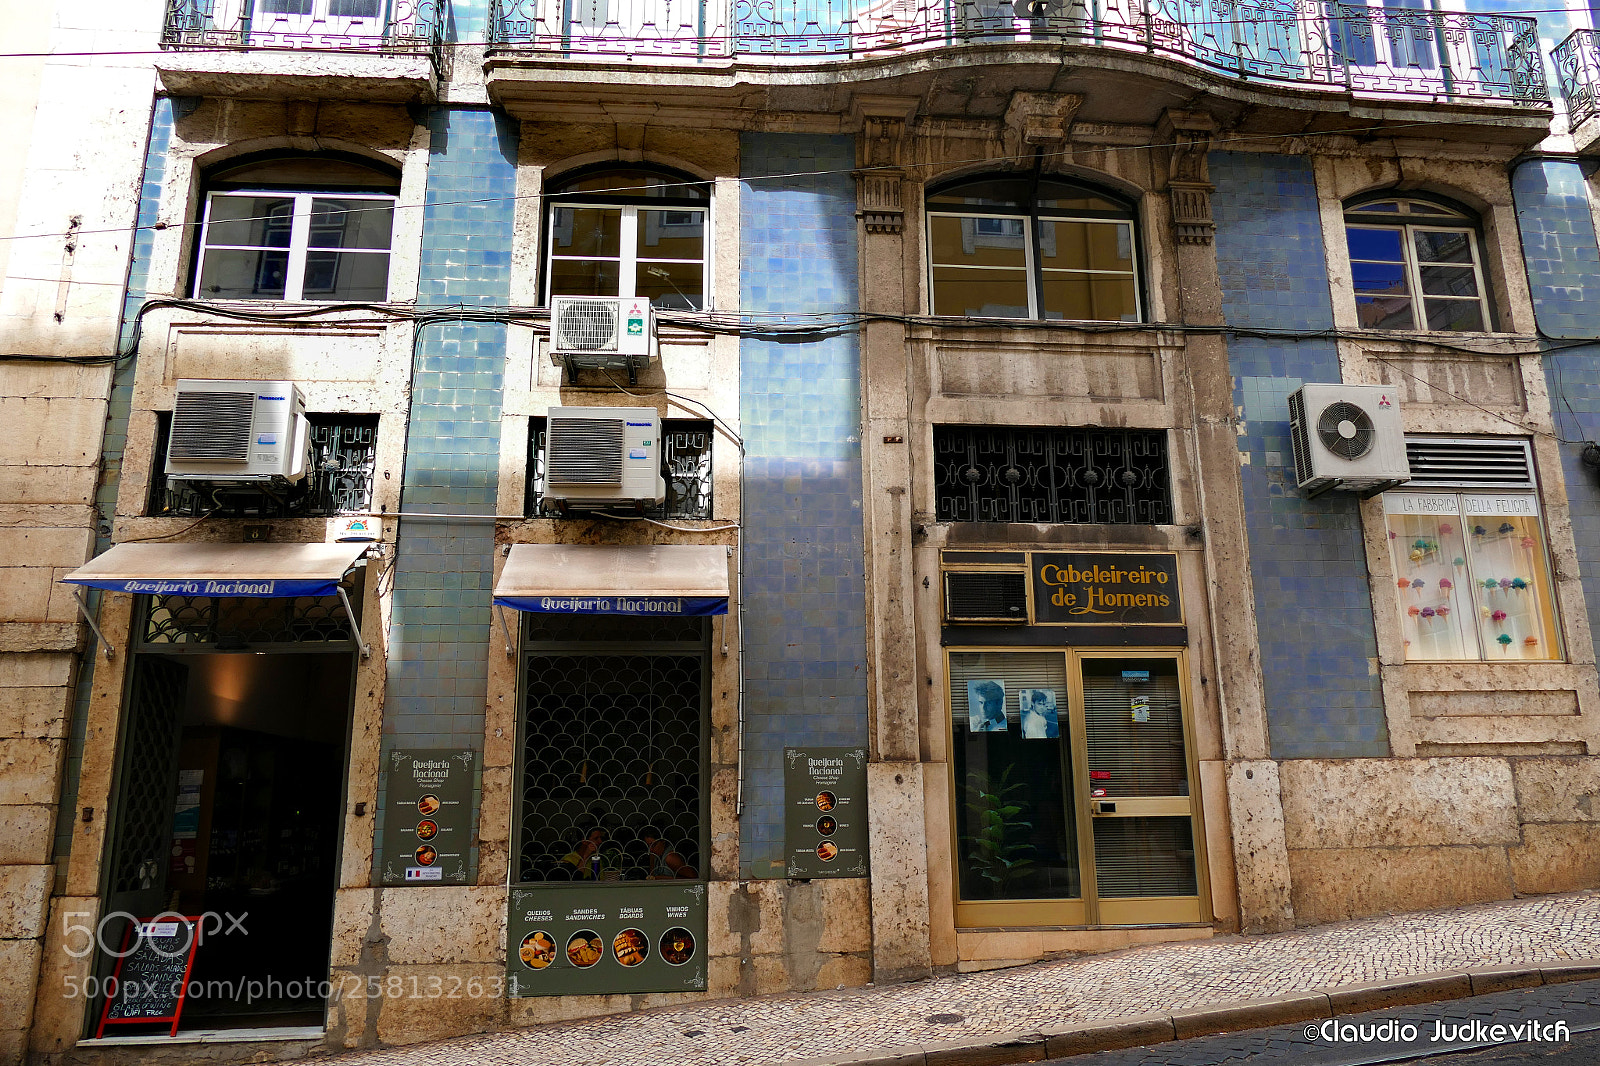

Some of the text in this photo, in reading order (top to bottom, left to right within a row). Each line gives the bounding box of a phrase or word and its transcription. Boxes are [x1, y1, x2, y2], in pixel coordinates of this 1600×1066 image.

[1402, 497, 1531, 513] LA FABBRICA DELLA FELICITÀ
[1040, 563, 1169, 588] Cabeleireiro
[124, 580, 275, 594] Queijaria Nacional
[540, 596, 682, 613] Queijaria Nacional
[1051, 585, 1170, 615] de Homens
[412, 759, 450, 771] Queijaria
[808, 757, 844, 767] Queijaria
[412, 769, 449, 778] Nacional
[808, 766, 843, 775] Nacional
